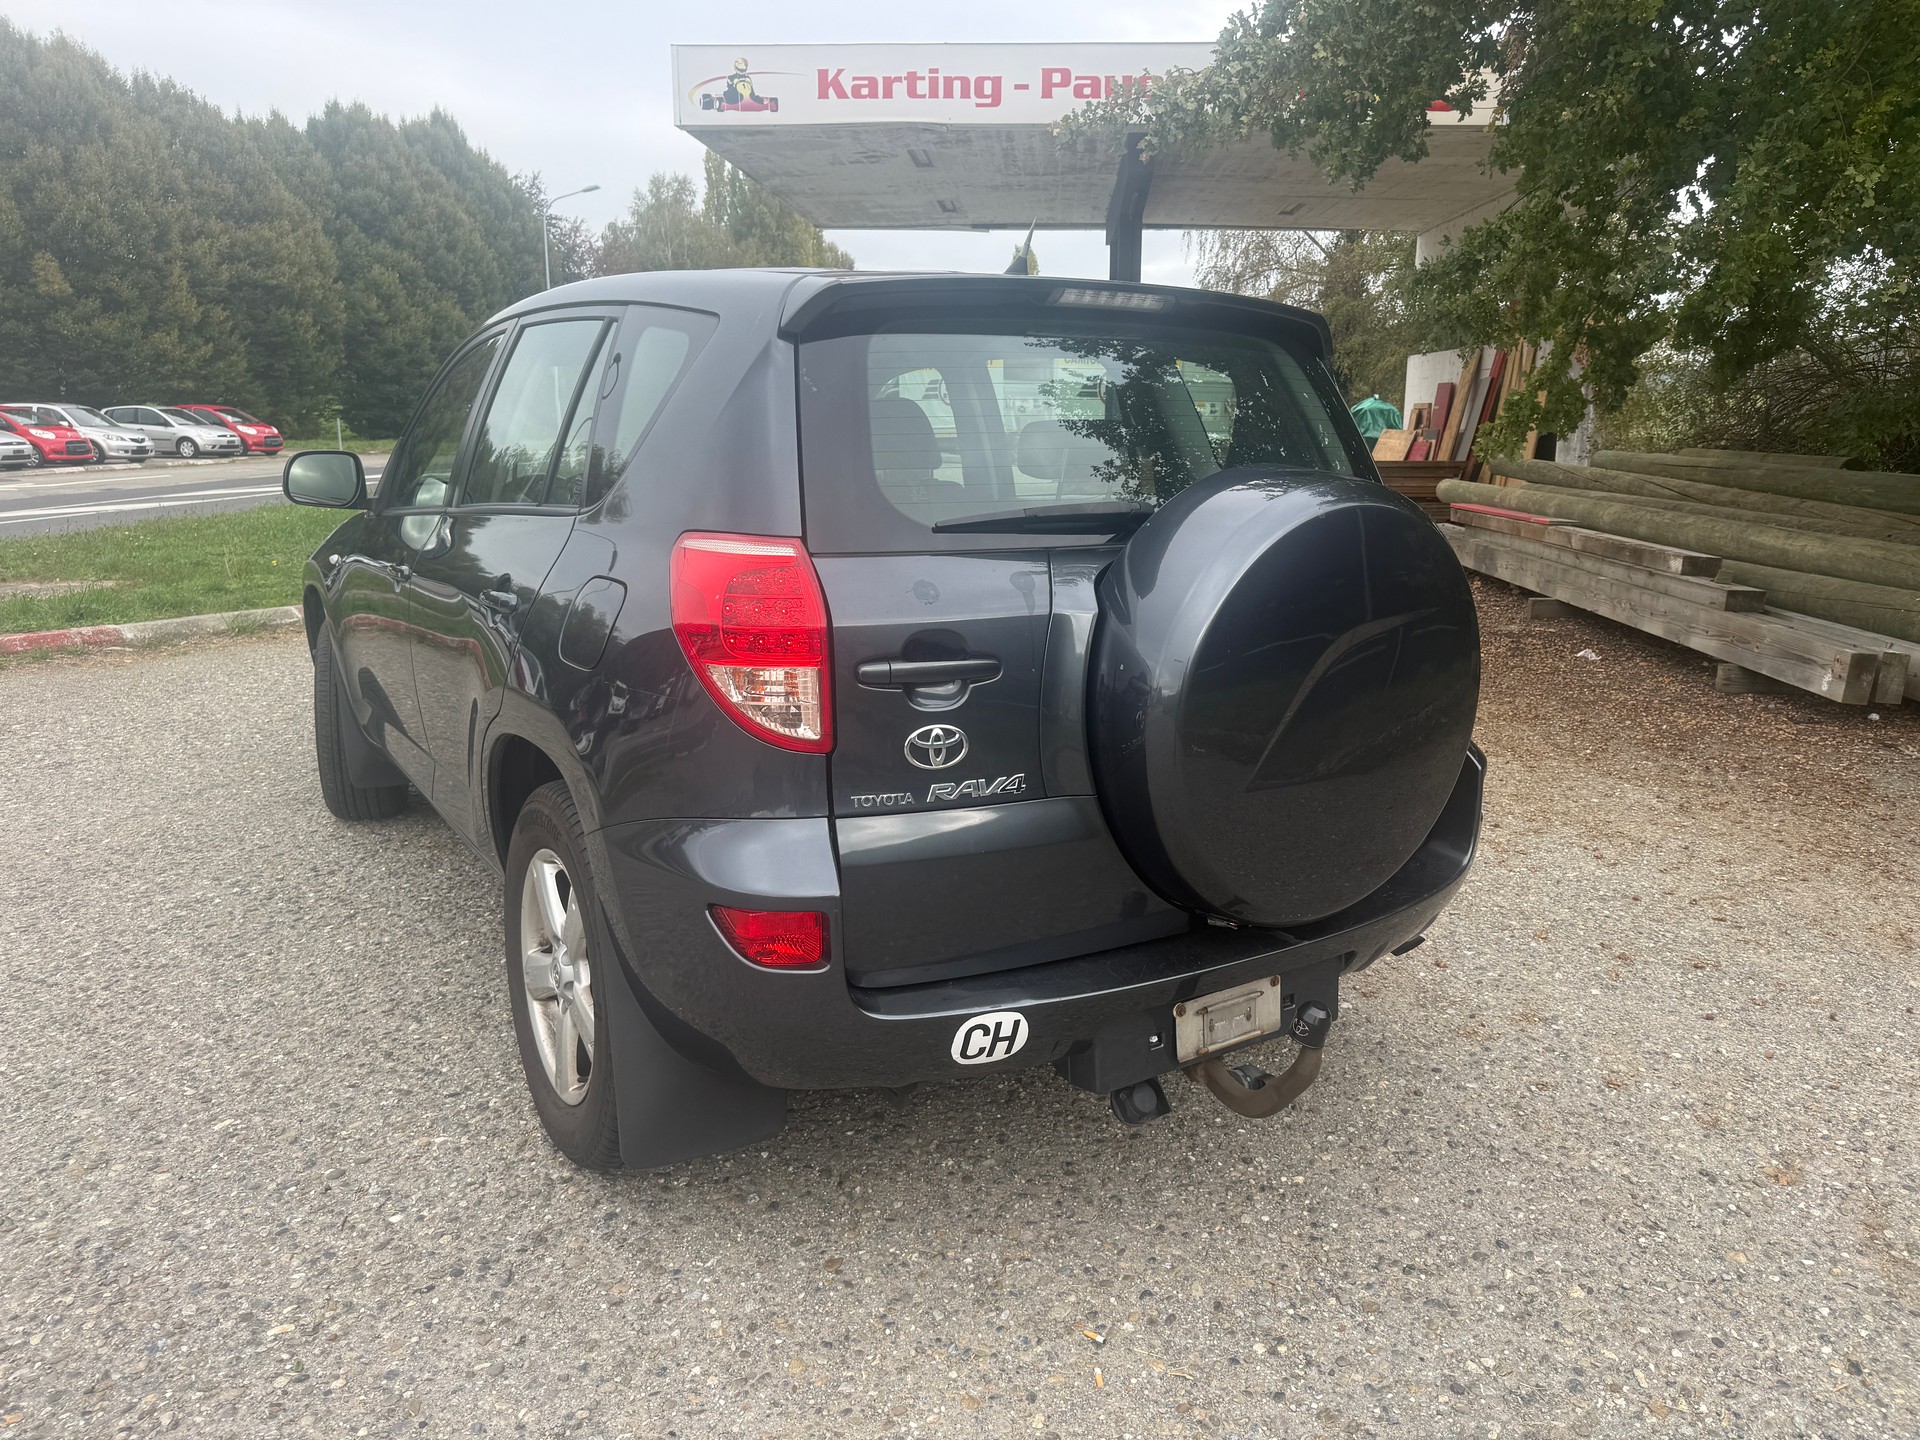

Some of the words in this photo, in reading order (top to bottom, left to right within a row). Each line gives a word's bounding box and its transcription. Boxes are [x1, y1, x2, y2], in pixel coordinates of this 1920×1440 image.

[817, 68, 1003, 108] Karting
[1013, 83, 1030, 91] -
[850, 792, 915, 808] TOYOTA
[926, 773, 1027, 803] RAV4
[959, 1018, 1022, 1060] CH
